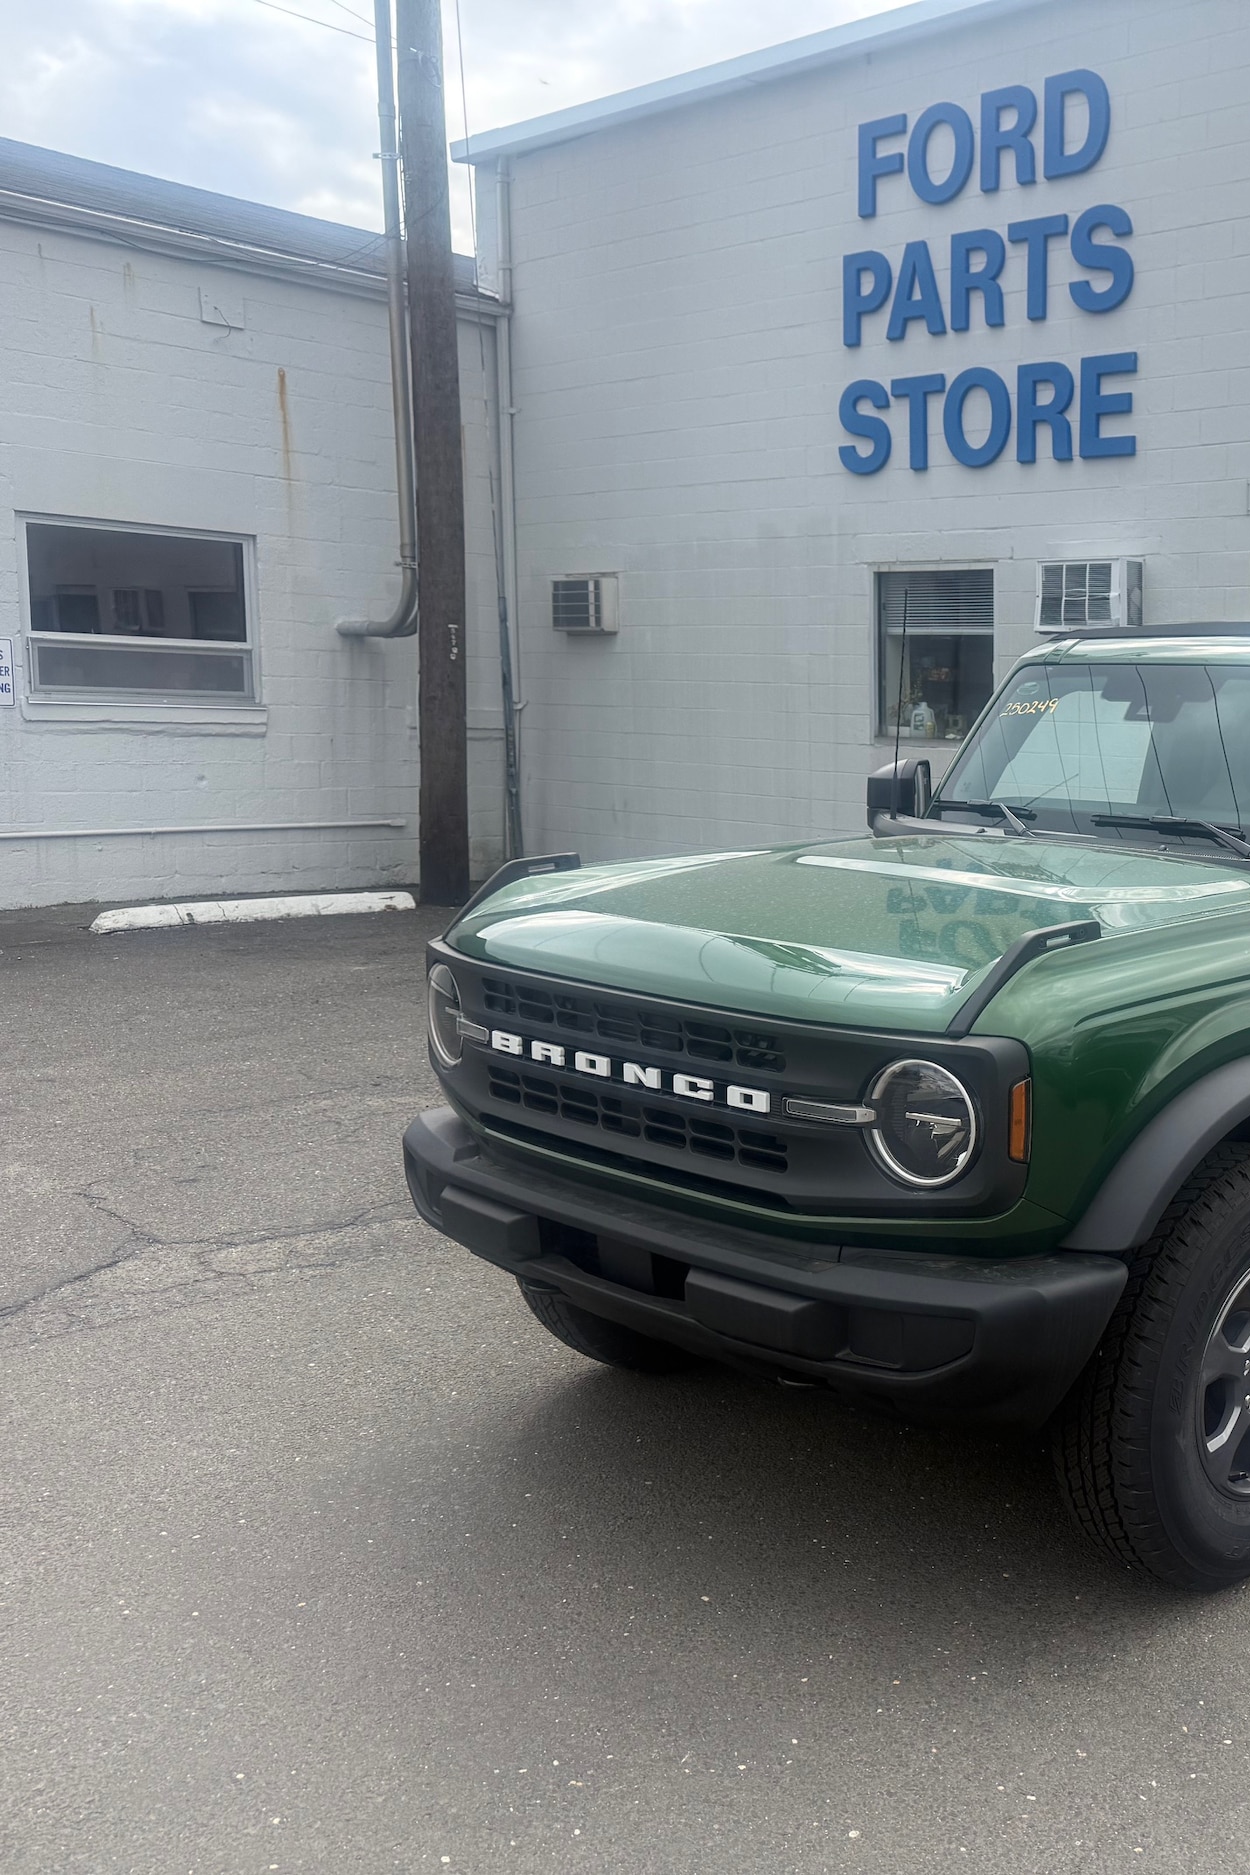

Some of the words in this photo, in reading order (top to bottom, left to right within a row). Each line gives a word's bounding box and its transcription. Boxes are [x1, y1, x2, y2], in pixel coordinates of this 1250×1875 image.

[858, 68, 1111, 219] FORD
[843, 204, 1134, 348] PARTS
[838, 352, 1138, 475] STORE
[1000, 698, 1060, 717] 250249
[491, 1030, 771, 1113] BRONCO
